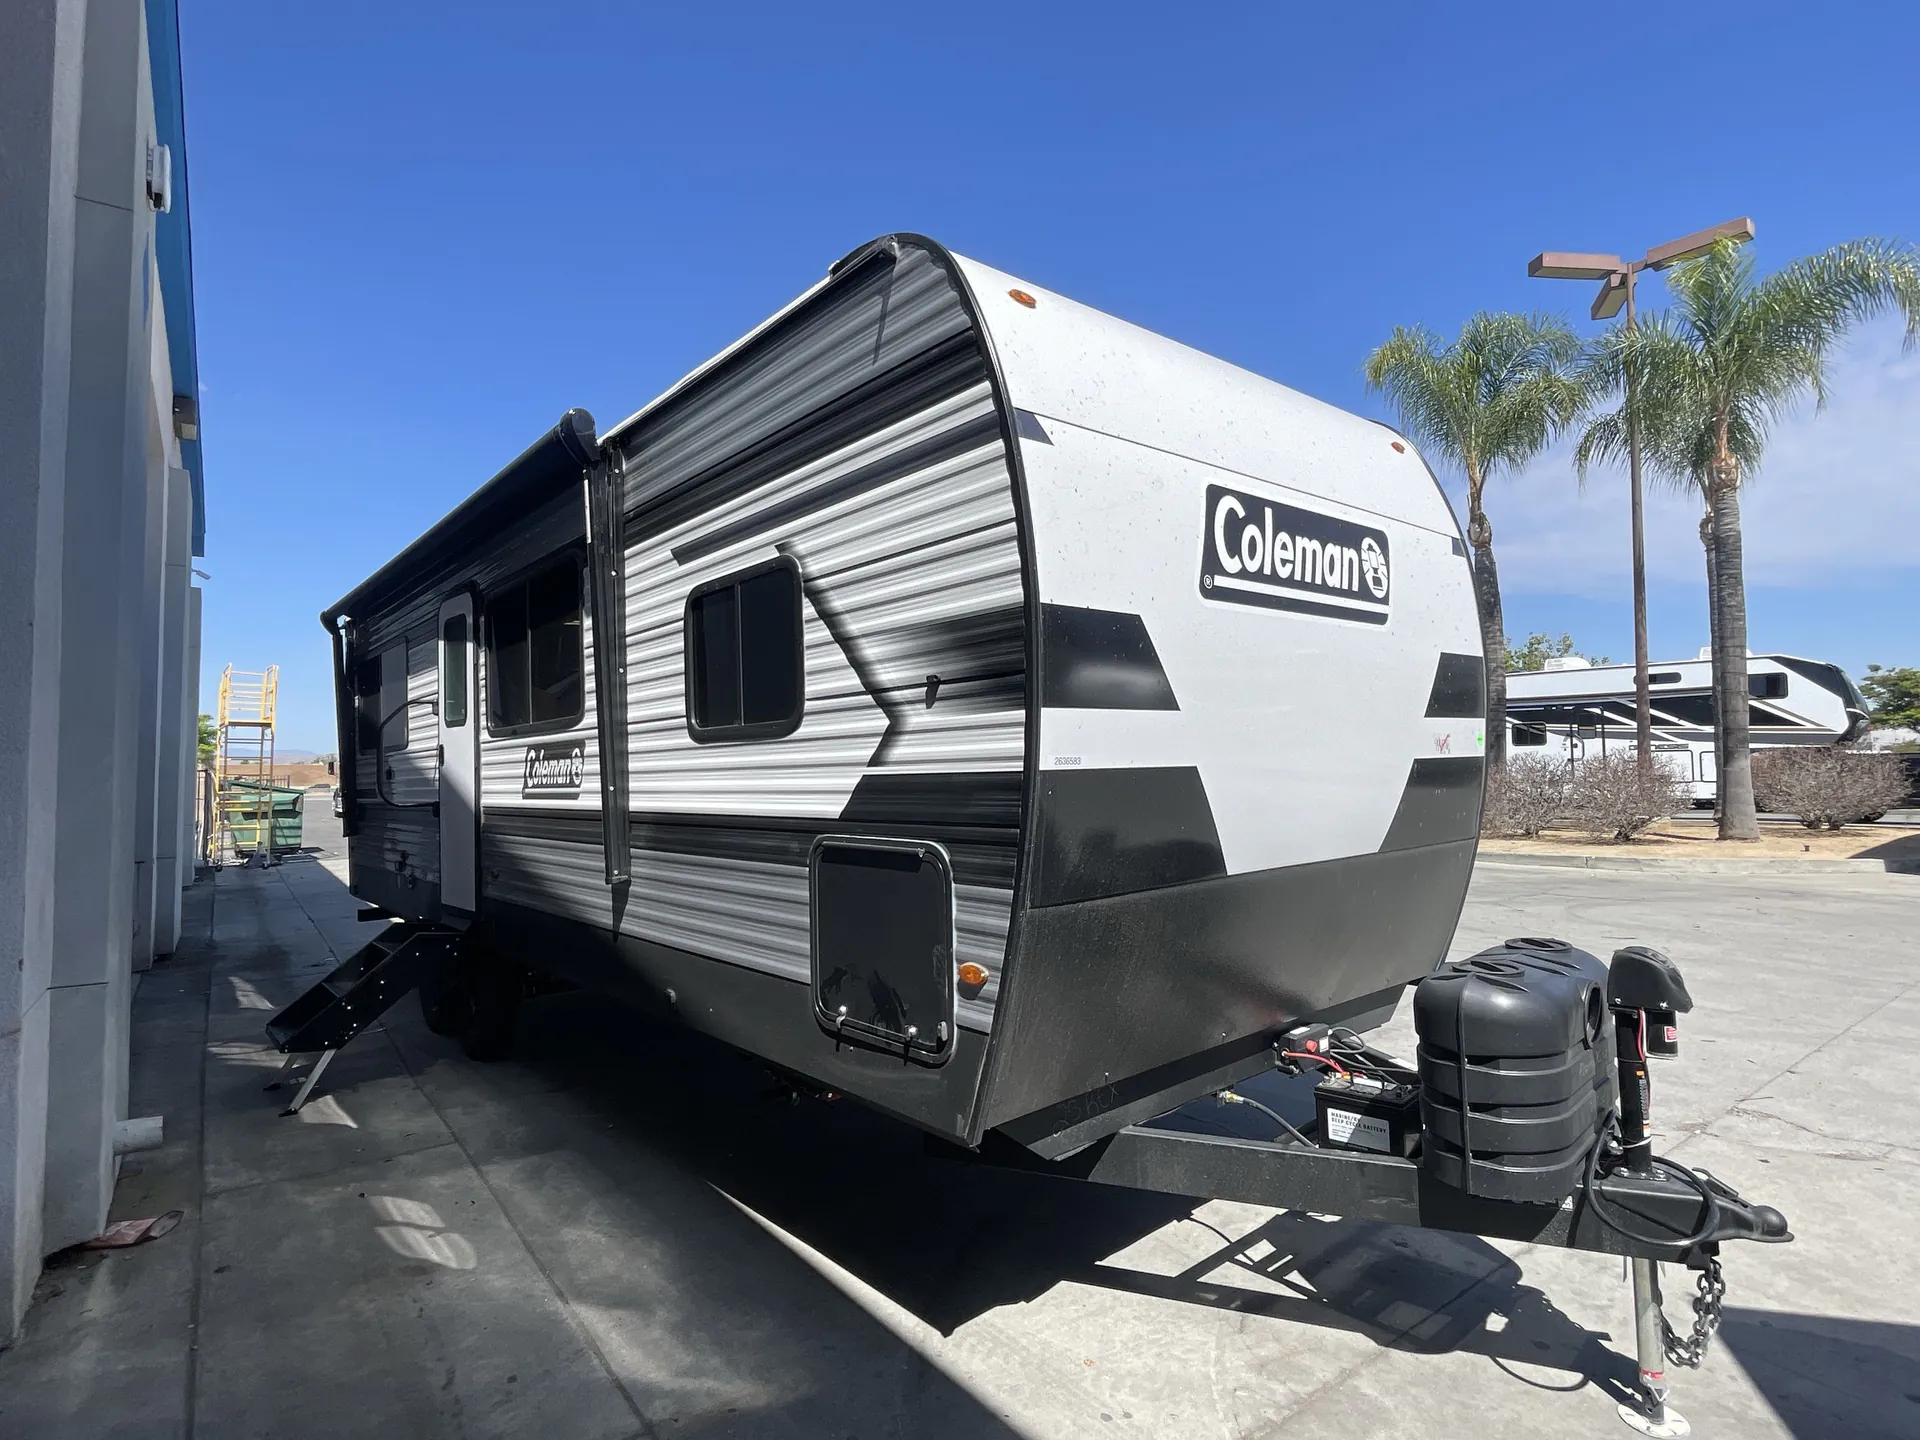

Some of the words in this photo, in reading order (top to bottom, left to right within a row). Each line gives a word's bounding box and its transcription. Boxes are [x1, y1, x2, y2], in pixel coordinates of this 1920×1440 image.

[1214, 495, 1359, 591] Coleman
[526, 749, 571, 787] Coleman
[1363, 1124, 1386, 1133] BATTERY
